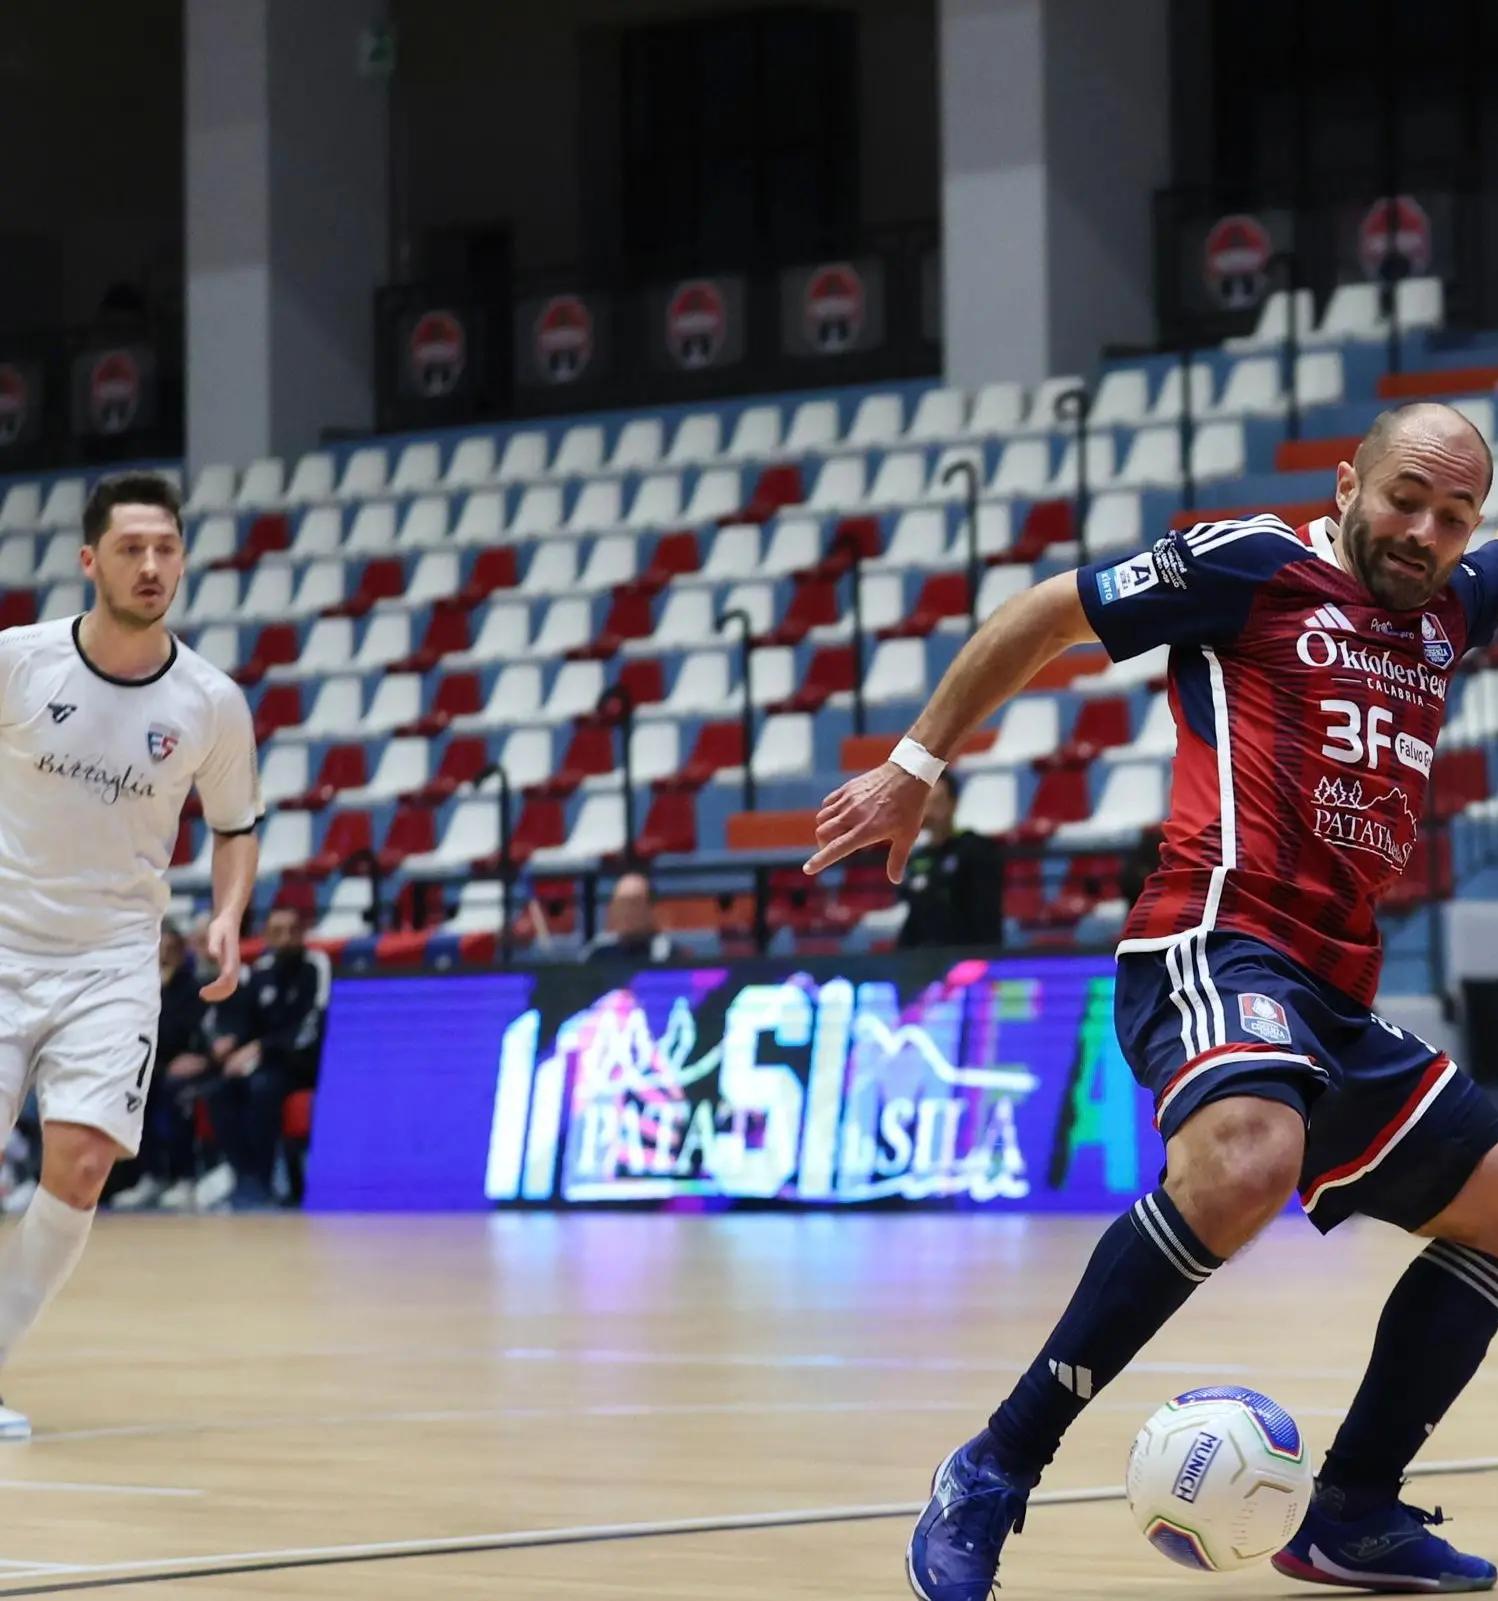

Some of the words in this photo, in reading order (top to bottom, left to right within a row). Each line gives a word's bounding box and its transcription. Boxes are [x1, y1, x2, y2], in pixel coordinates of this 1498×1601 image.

[1366, 678, 1424, 706] CALABRIA
[1320, 700, 1393, 770] 3F
[1399, 738, 1424, 763] Falvo
[1314, 808, 1392, 855] PATATA
[136, 1033, 152, 1089] 7
[1175, 1431, 1219, 1504] MUNICH
